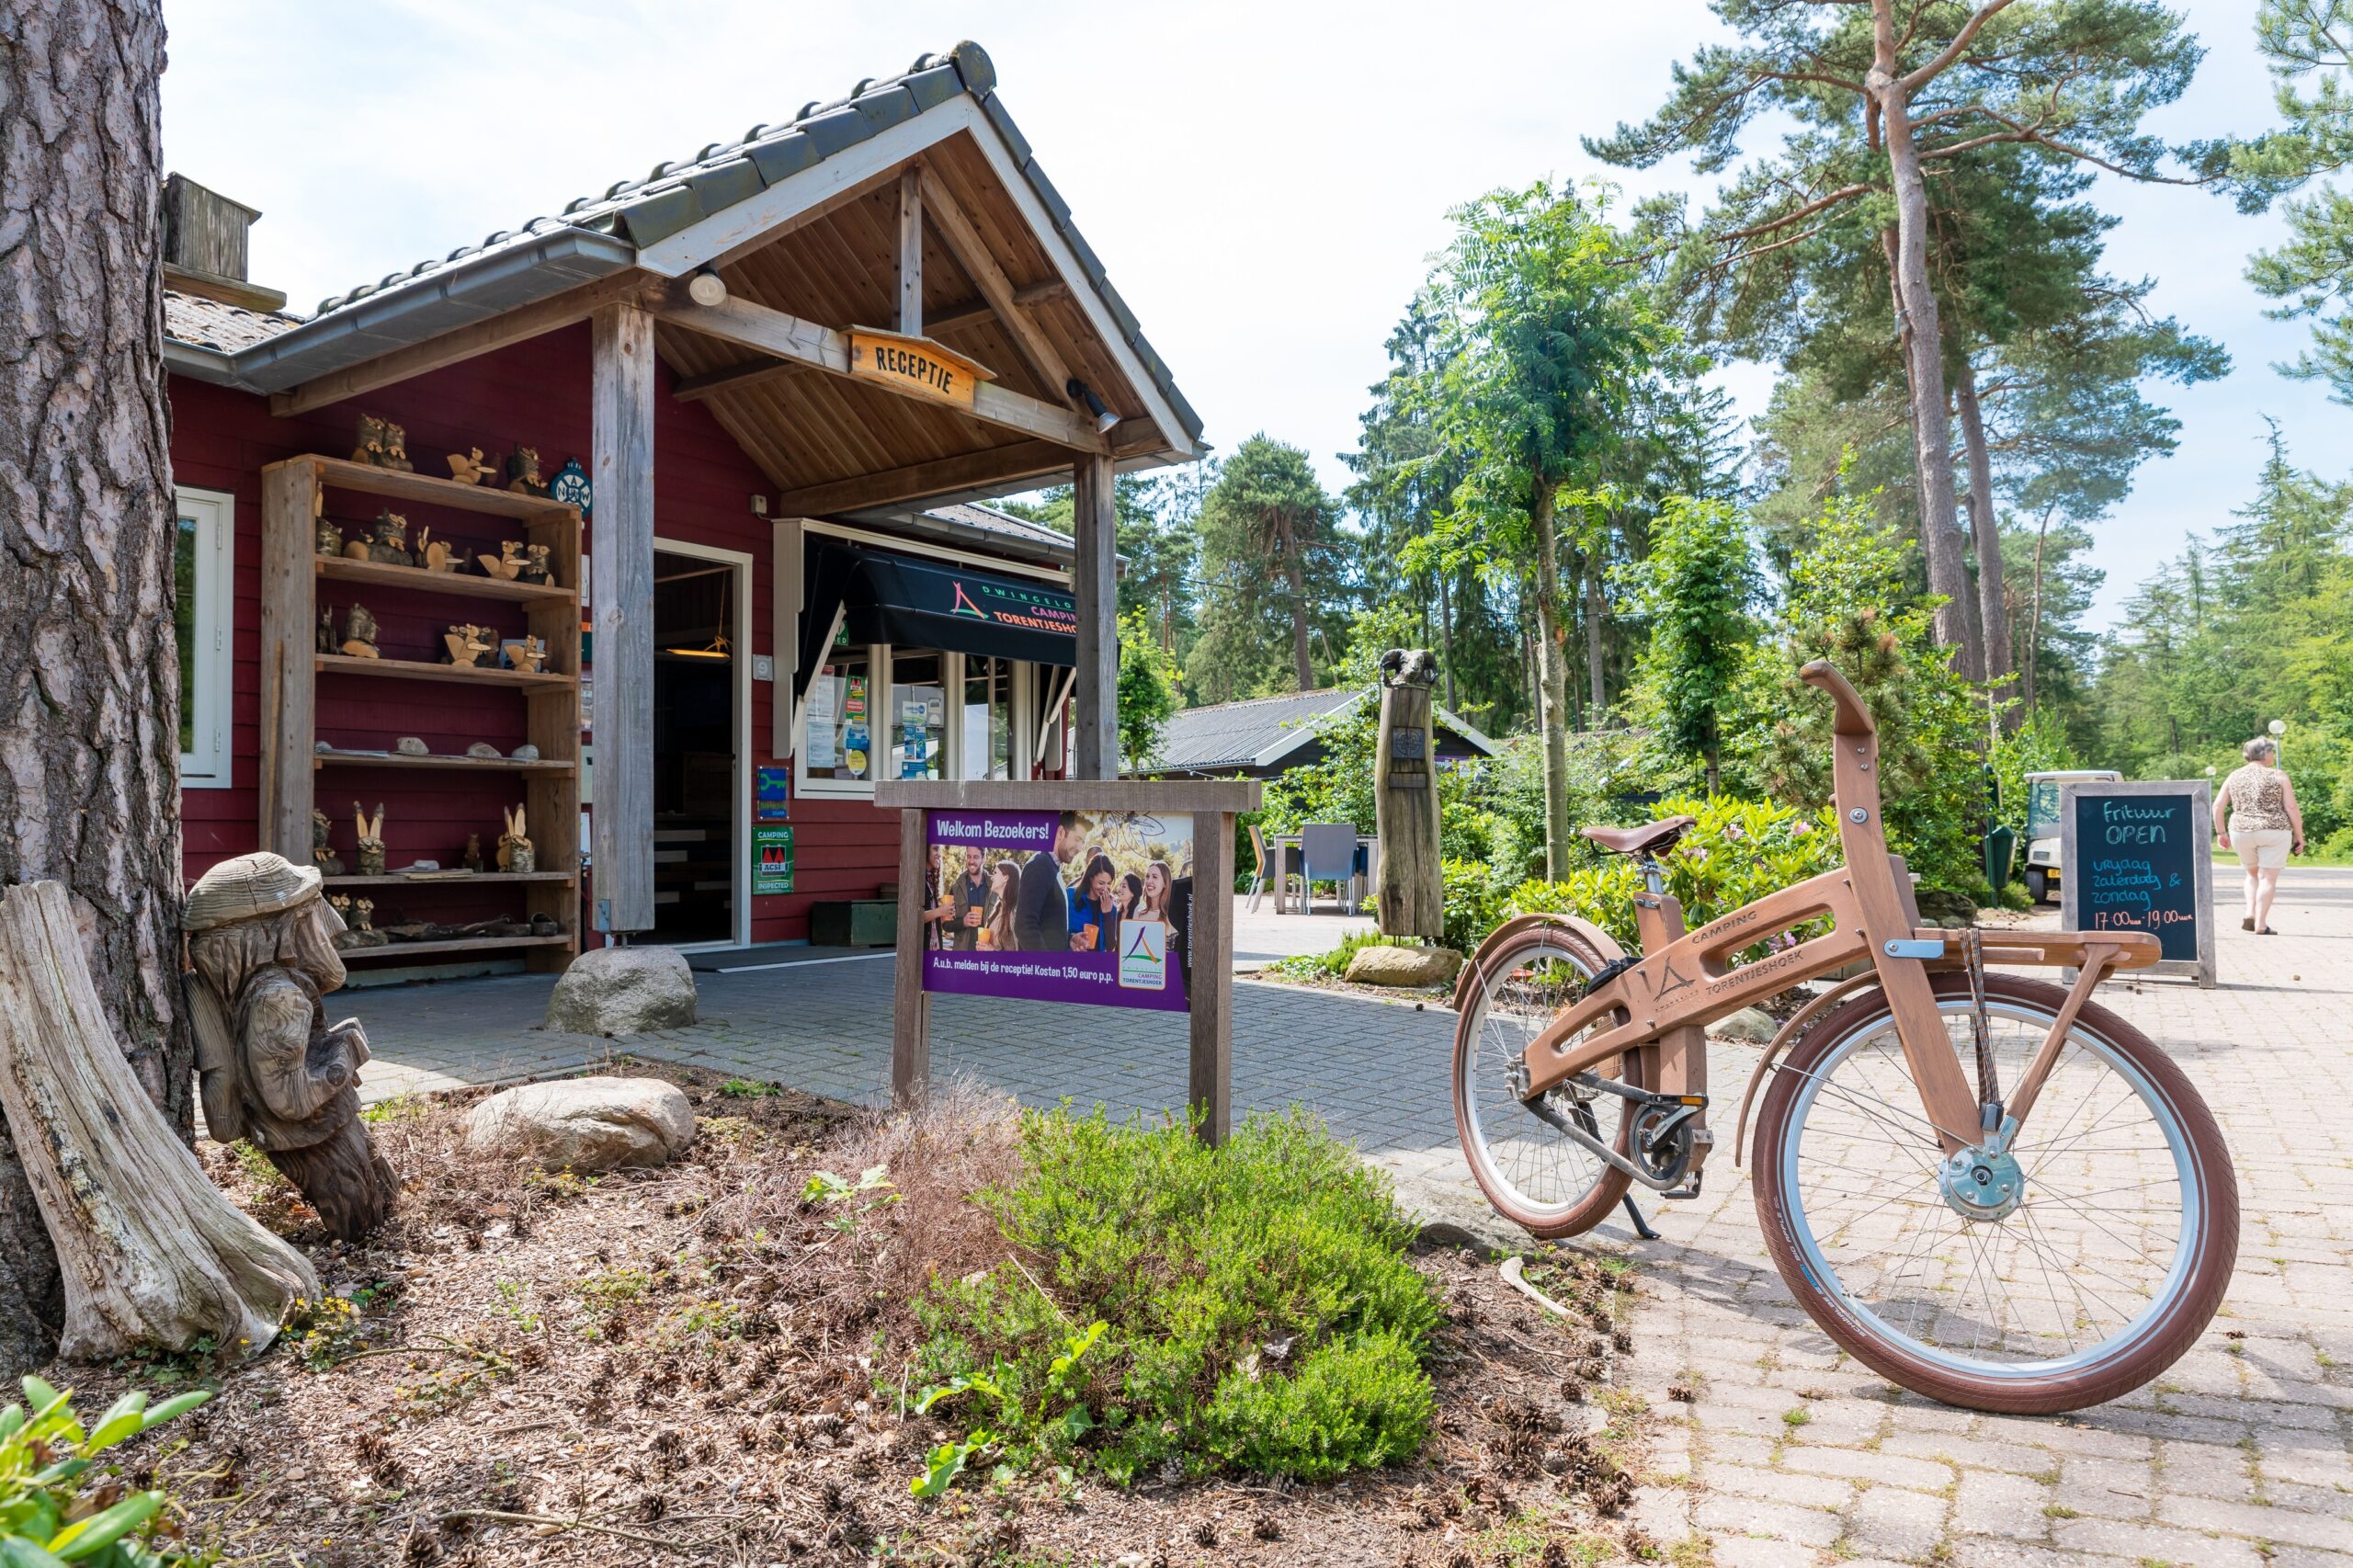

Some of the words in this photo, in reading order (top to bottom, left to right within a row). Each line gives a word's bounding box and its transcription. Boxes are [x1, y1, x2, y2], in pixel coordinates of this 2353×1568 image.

[876, 347, 953, 394] RECEPTIE
[982, 585, 1072, 608] DWINGELO
[994, 611, 1077, 634] TORENTJESHO
[1030, 606, 1077, 622] CAMPIN
[757, 831, 789, 839] CAMPING
[937, 819, 982, 837] Welkom
[984, 820, 1049, 839] Bezoekers!
[2106, 825, 2165, 844] OPEN
[757, 881, 789, 890] INSPECTED
[2169, 872, 2183, 887] &
[1692, 910, 1757, 944] CAMPING
[933, 957, 953, 969] A.u.b.
[954, 960, 979, 971] melden
[980, 960, 989, 974] bij
[990, 961, 999, 972] de
[1001, 964, 1033, 977] receptie!
[1034, 964, 1061, 977] Kosten
[1062, 966, 1078, 979] 1,50
[1079, 971, 1097, 980] euro
[1098, 972, 1113, 983] p.p.
[1706, 949, 1804, 995] TORENTJESHOEK
[1122, 977, 1163, 985] TORENTJESHOEK
